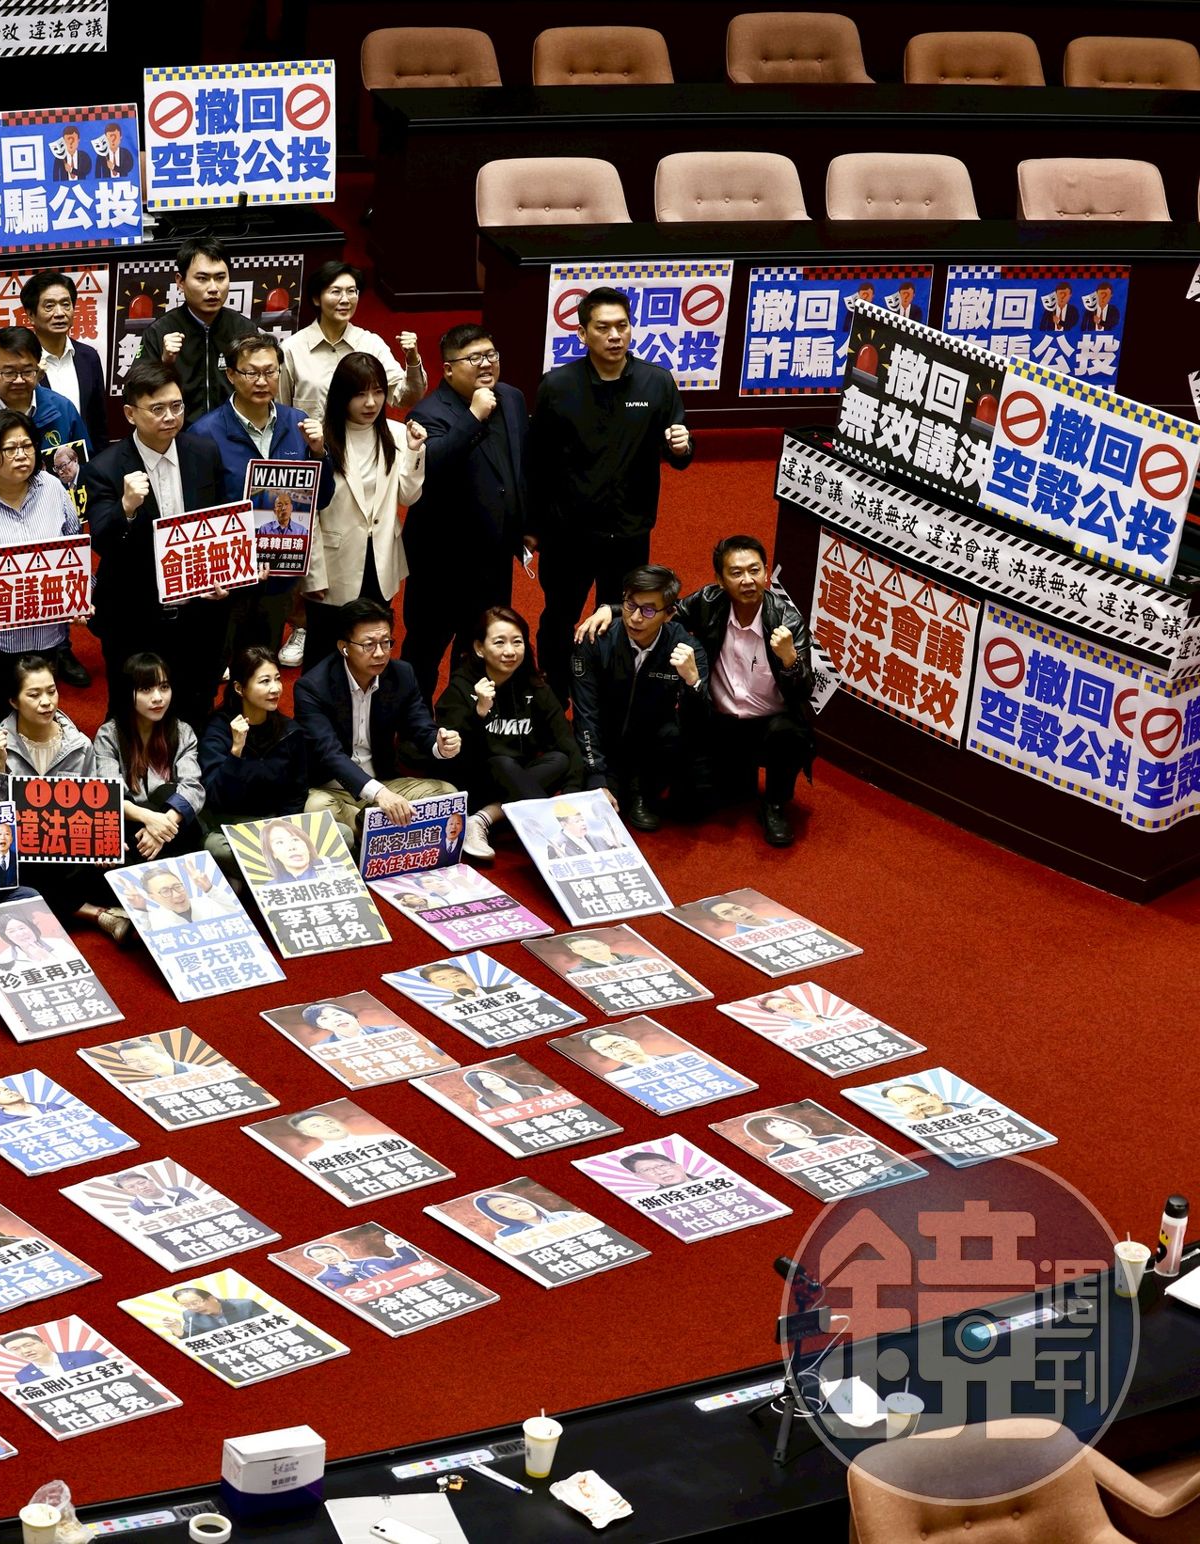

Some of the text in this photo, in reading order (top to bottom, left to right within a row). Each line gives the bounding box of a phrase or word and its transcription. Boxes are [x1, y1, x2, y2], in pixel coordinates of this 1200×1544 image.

[29, 17, 103, 40] 違法會議
[195, 86, 283, 134] 撤回
[150, 136, 331, 189] 空殼公投
[751, 287, 838, 332] 撤回
[949, 288, 1034, 332] 撤回
[887, 342, 971, 419] 撤回
[1046, 401, 1144, 489] 撤回
[254, 468, 314, 487] WANTED
[987, 447, 1178, 566] 空殼公投
[255, 537, 304, 550] 尋韓國瑜
[781, 456, 1182, 640] 違法會議 決議無效 違法會議 決議無效 違法會議
[161, 534, 256, 595] 會議無效
[818, 565, 966, 680] 違法會議
[814, 615, 960, 730] 表決無效
[1025, 650, 1115, 728] 撤回
[16, 809, 120, 856] 違法會議
[369, 826, 441, 856] 縱容黑道
[366, 849, 439, 878] 放任紅統
[571, 871, 647, 898] 陳雪生
[279, 900, 360, 929] 李彥秀
[582, 890, 657, 916] 怕罷免
[290, 920, 372, 949] 怕罷免
[457, 920, 539, 943] 怕罷免
[176, 940, 256, 973] 廖先翔
[769, 944, 845, 970] 怕罷免
[187, 960, 267, 994] 怕罷免
[18, 980, 97, 1010] 陳玉珍
[608, 985, 692, 1010] 怕罷免
[467, 1001, 540, 1030] 羅明才
[484, 1013, 564, 1041] 怕罷免
[356, 1057, 439, 1082] 怕罷免
[828, 1042, 907, 1068] 怕罷免
[155, 1081, 244, 1110] 羅智強
[170, 1095, 257, 1122] 怕罷免
[654, 1079, 737, 1108] 怕罷免
[503, 1107, 588, 1137] 萬美玲
[521, 1120, 606, 1148] 怕罷免
[934, 1119, 1018, 1148] 陳超明
[13, 1122, 99, 1153] 洪孟楷
[28, 1137, 114, 1165] 怕罷免
[952, 1132, 1036, 1158] 怕罷免
[309, 1138, 409, 1171] 解顏行動
[802, 1153, 883, 1183] 呂玉玲
[352, 1167, 439, 1196] 怕罷免
[818, 1167, 903, 1194] 怕罷免
[665, 1191, 748, 1221] 林思銘
[681, 1204, 765, 1232] 怕罷免
[178, 1227, 265, 1259] 怕罷免
[528, 1231, 614, 1265] 邱若華
[546, 1245, 633, 1278] 怕罷免
[389, 1292, 477, 1326] 怕罷免
[212, 1330, 305, 1367] 林德福
[230, 1343, 323, 1379] 怕罷免
[39, 1381, 139, 1416] 張智倫
[57, 1395, 155, 1431] 怕罷免
